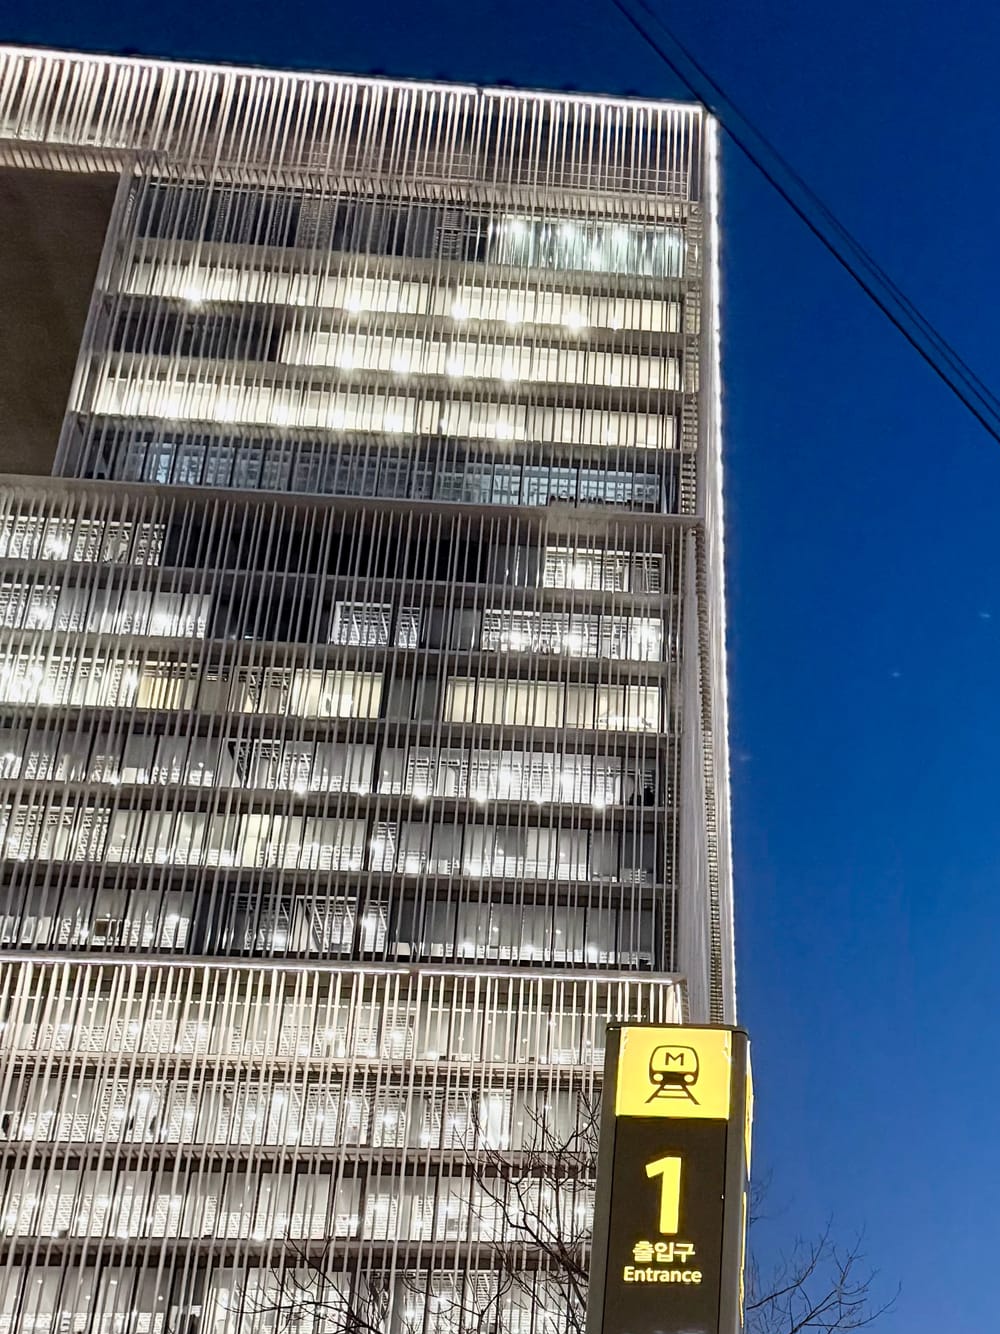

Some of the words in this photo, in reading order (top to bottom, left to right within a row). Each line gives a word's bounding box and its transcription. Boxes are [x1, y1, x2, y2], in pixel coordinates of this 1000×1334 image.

[645, 1156, 681, 1234] 1
[633, 1241, 696, 1263] 출입구
[623, 1265, 702, 1283] Entrance
